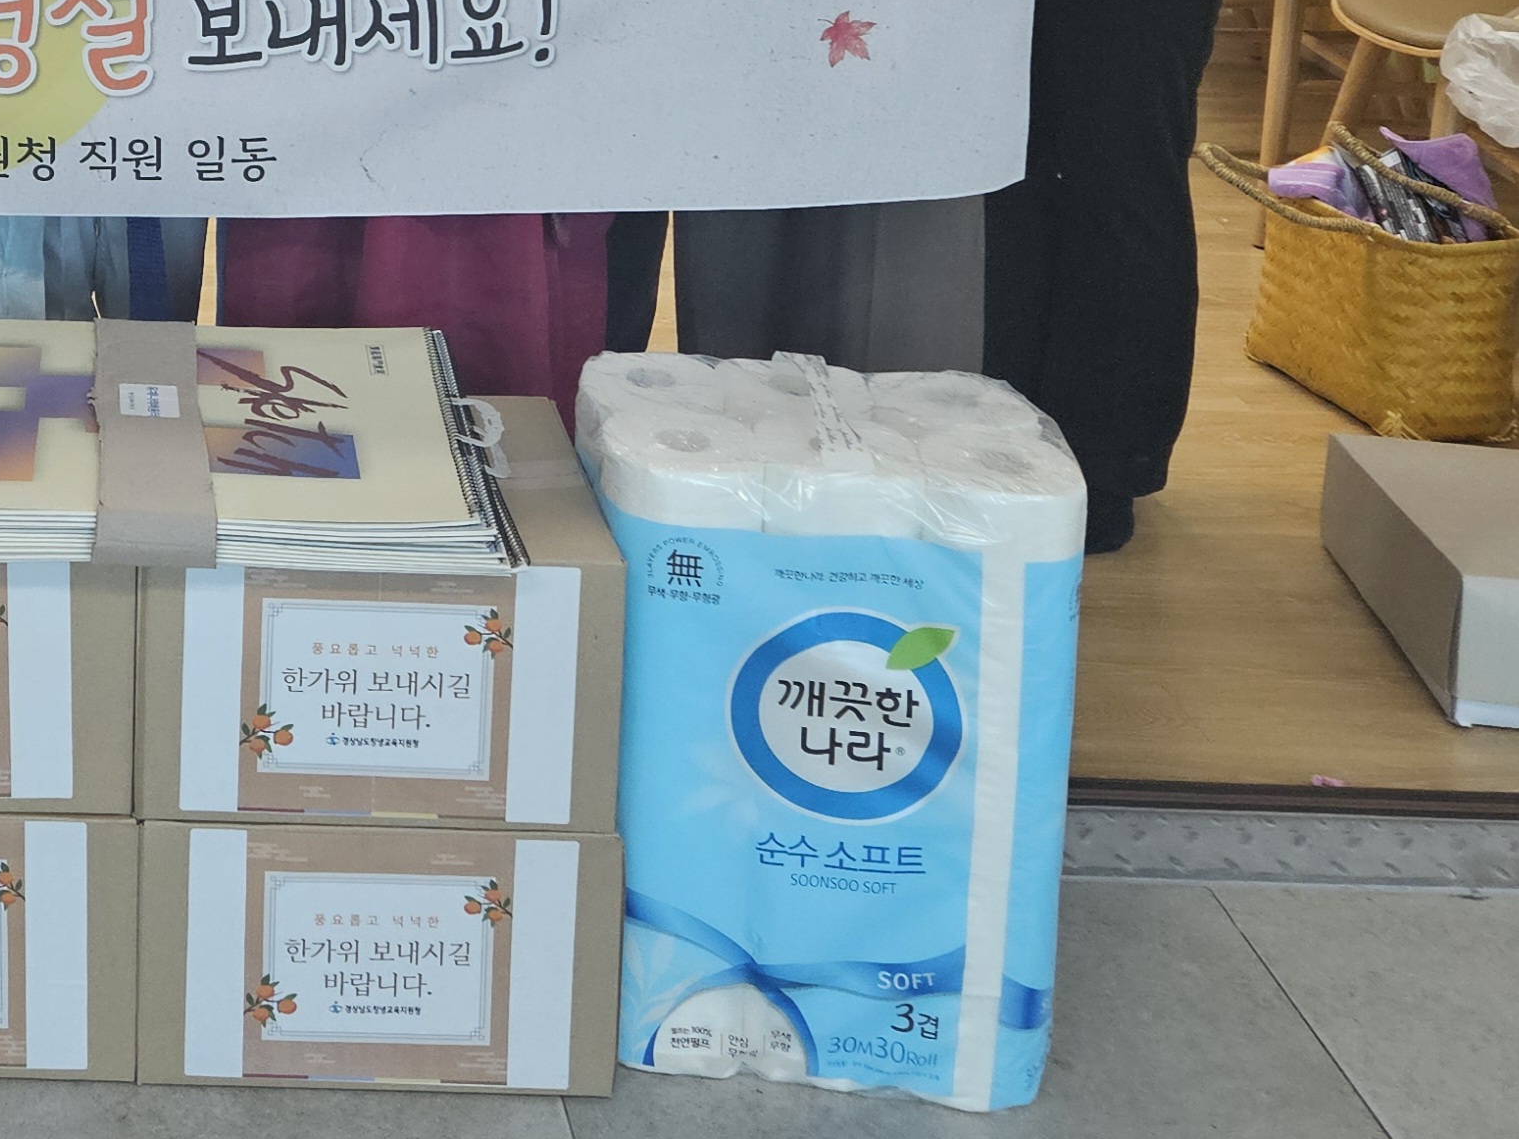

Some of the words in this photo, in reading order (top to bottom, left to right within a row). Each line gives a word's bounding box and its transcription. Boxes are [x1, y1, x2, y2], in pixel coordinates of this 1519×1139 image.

[79, 137, 164, 183] 직원
[187, 134, 278, 183] 일동
[662, 536, 695, 546] POWER
[282, 667, 358, 695] 한가위
[368, 671, 471, 699] 보내시길
[321, 702, 430, 730] 바랍니다.
[778, 679, 919, 727] 깨끗한
[801, 726, 891, 771] 나라
[755, 832, 819, 868] 순수
[824, 841, 926, 874] 소프트
[790, 873, 859, 892] SOONSOO
[863, 881, 897, 895] SOFT
[284, 938, 360, 964] 한가위
[369, 940, 471, 967] 보내시길
[324, 971, 432, 998] 바랍니다.
[877, 971, 936, 990] SOFT
[890, 1003, 939, 1040] 3겹
[670, 1037, 711, 1049] 천연펄프
